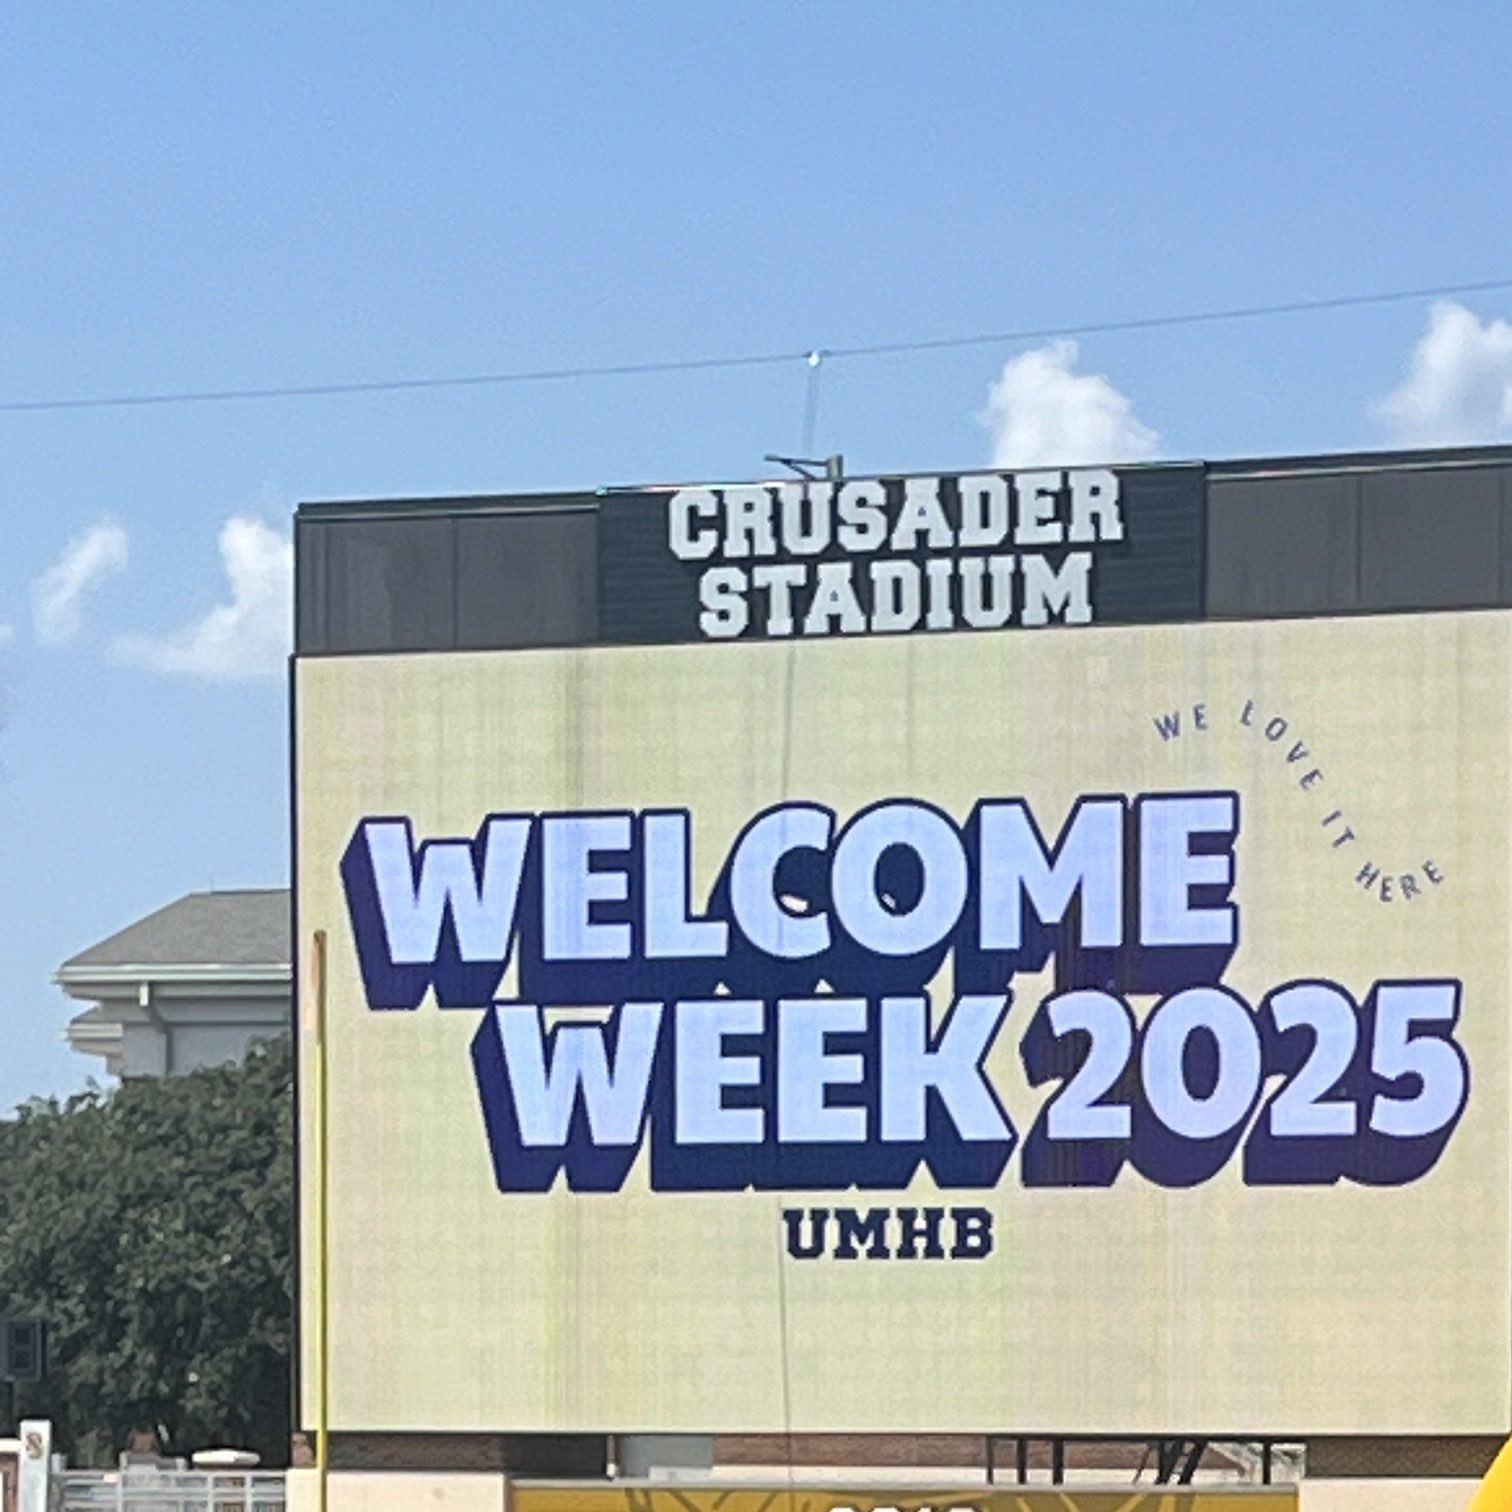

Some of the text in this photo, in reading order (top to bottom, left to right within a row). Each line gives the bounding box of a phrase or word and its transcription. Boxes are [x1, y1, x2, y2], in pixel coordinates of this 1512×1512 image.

[668, 468, 1123, 560] CRUSADER
[700, 551, 1093, 638] STADIUM
[1154, 700, 1444, 902] WE LOVE IT HERE
[342, 791, 1240, 1005] WELCOME
[474, 979, 1469, 1190] WEEK 2025
[783, 1207, 993, 1259] UMHB
